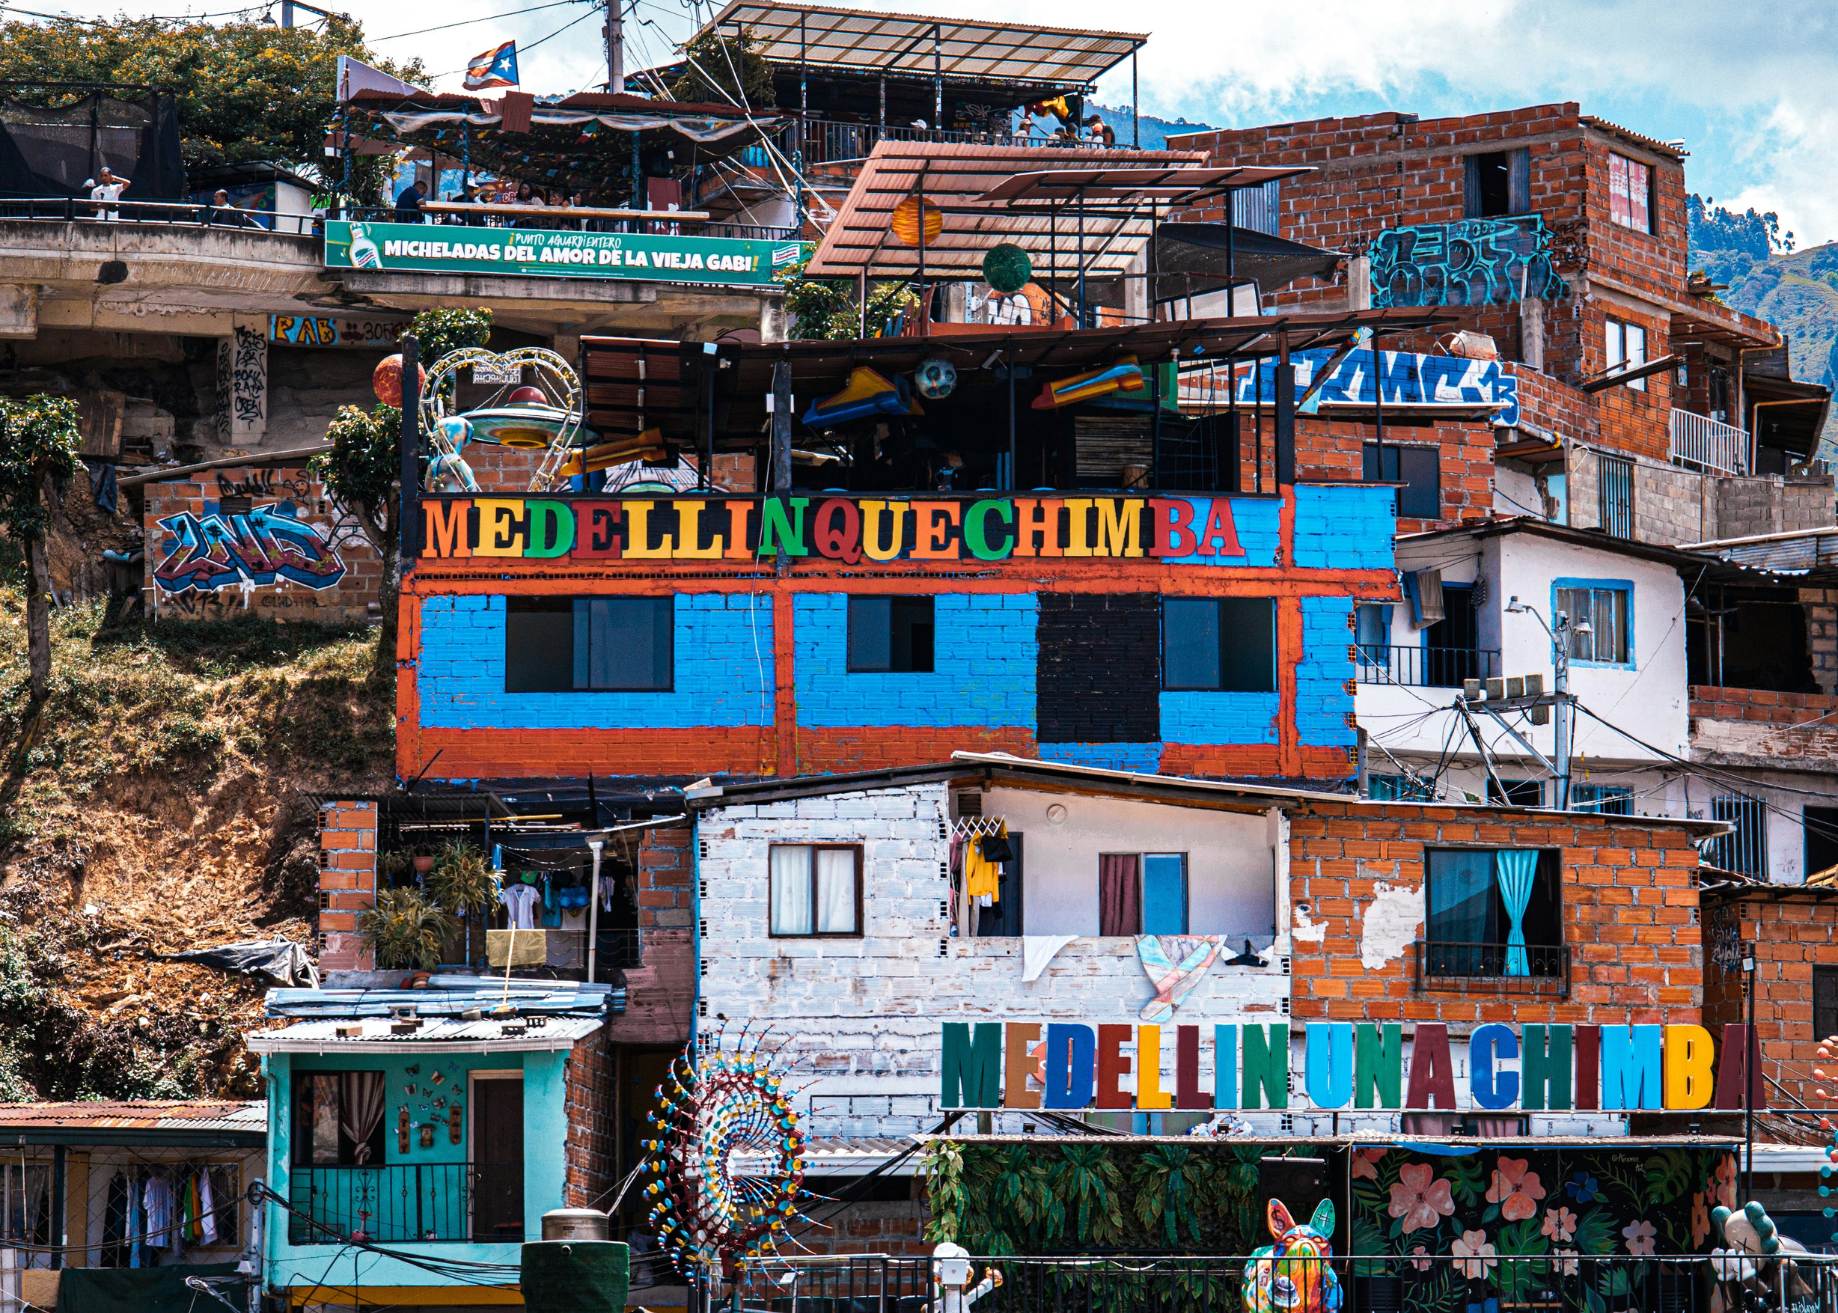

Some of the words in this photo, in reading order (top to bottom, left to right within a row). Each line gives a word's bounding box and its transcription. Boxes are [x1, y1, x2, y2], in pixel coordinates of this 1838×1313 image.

[384, 239, 501, 261] MICHELADAS
[504, 245, 537, 262] DEL
[539, 247, 596, 264] AMOR
[598, 249, 623, 266] DE
[625, 250, 648, 268] LA
[651, 251, 704, 270] VIEJA
[706, 253, 759, 272] GABI!
[941, 1021, 1289, 1110] MEDELLIN
[1305, 1022, 1457, 1110] UNA
[1469, 1023, 1767, 1111] CHIMBA
